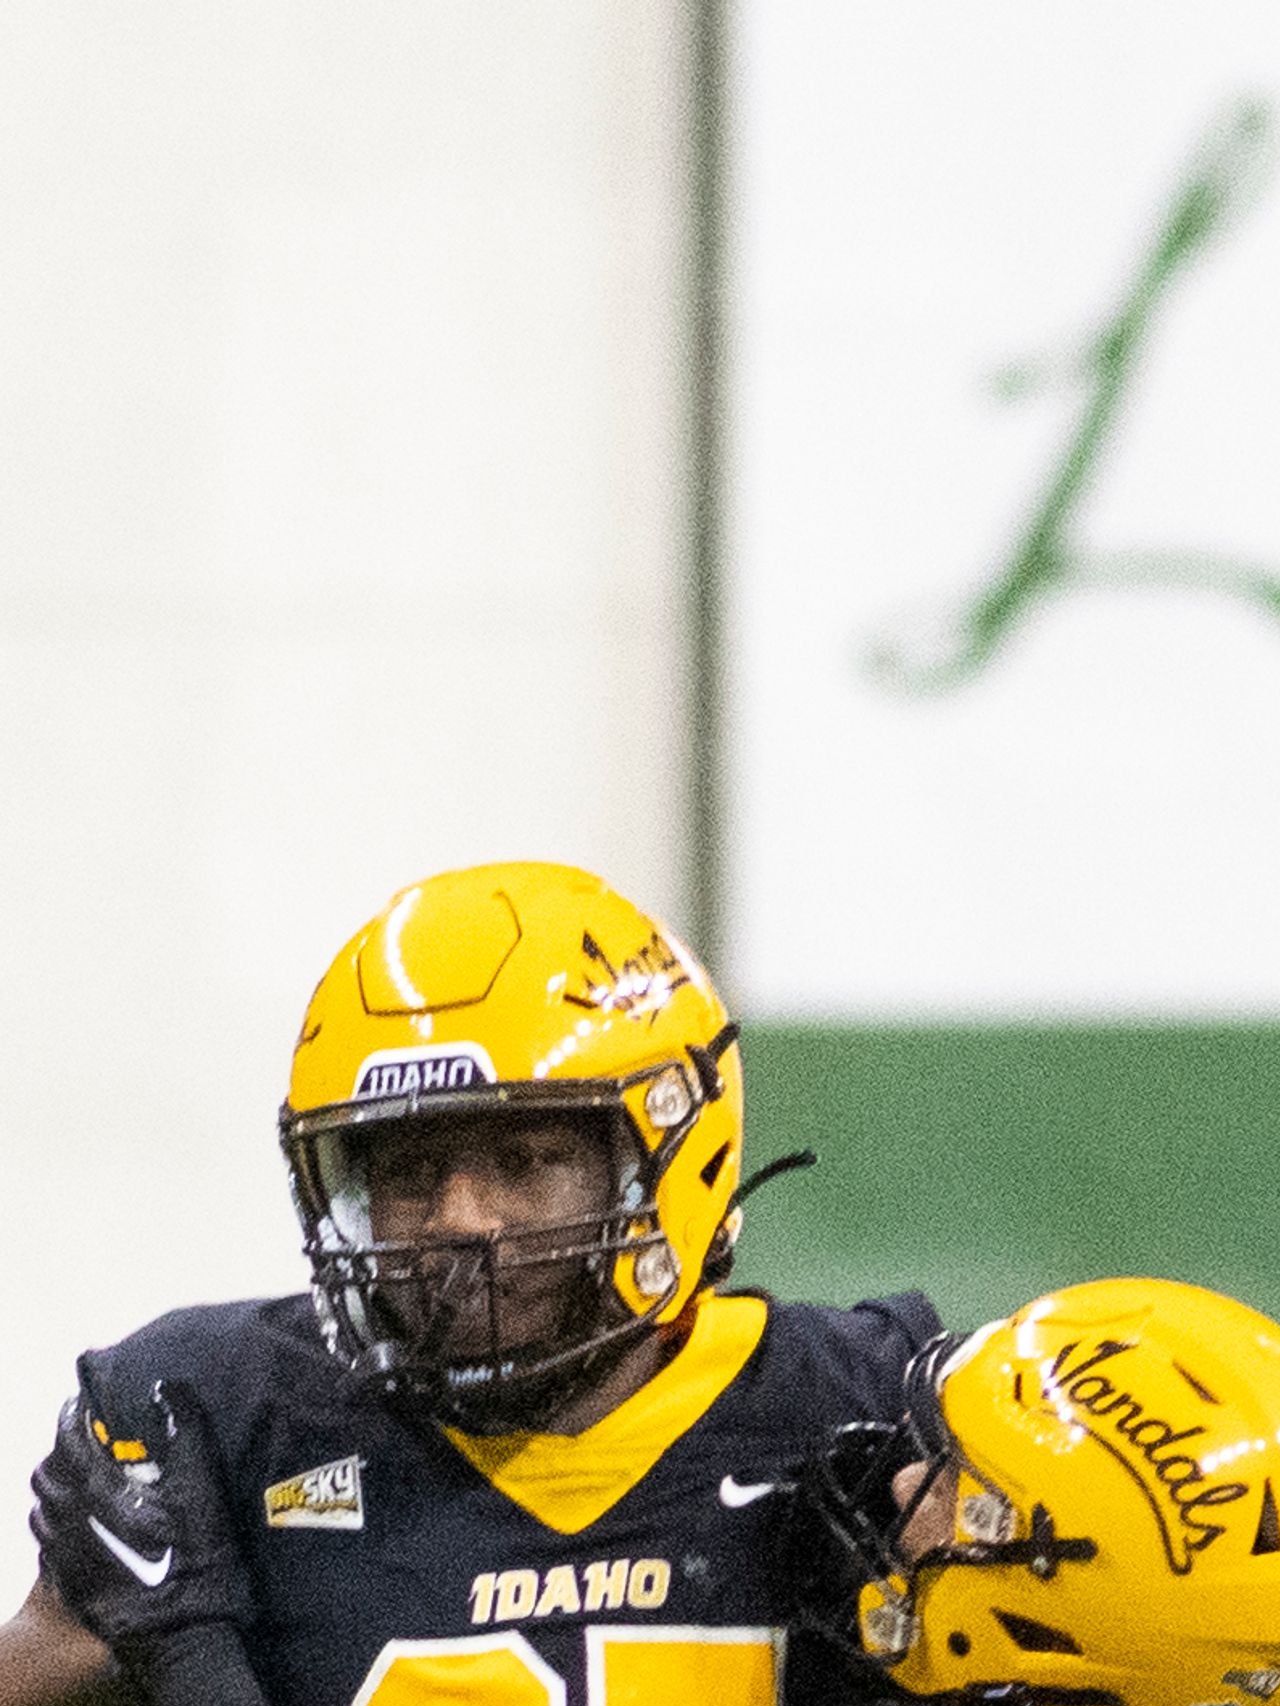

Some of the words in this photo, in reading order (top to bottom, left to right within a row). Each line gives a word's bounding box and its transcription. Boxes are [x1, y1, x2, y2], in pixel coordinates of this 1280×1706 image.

[363, 1056, 474, 1098] IDAHO
[1041, 1340, 1250, 1575] Vandals
[469, 1558, 671, 1624] IDAHO
